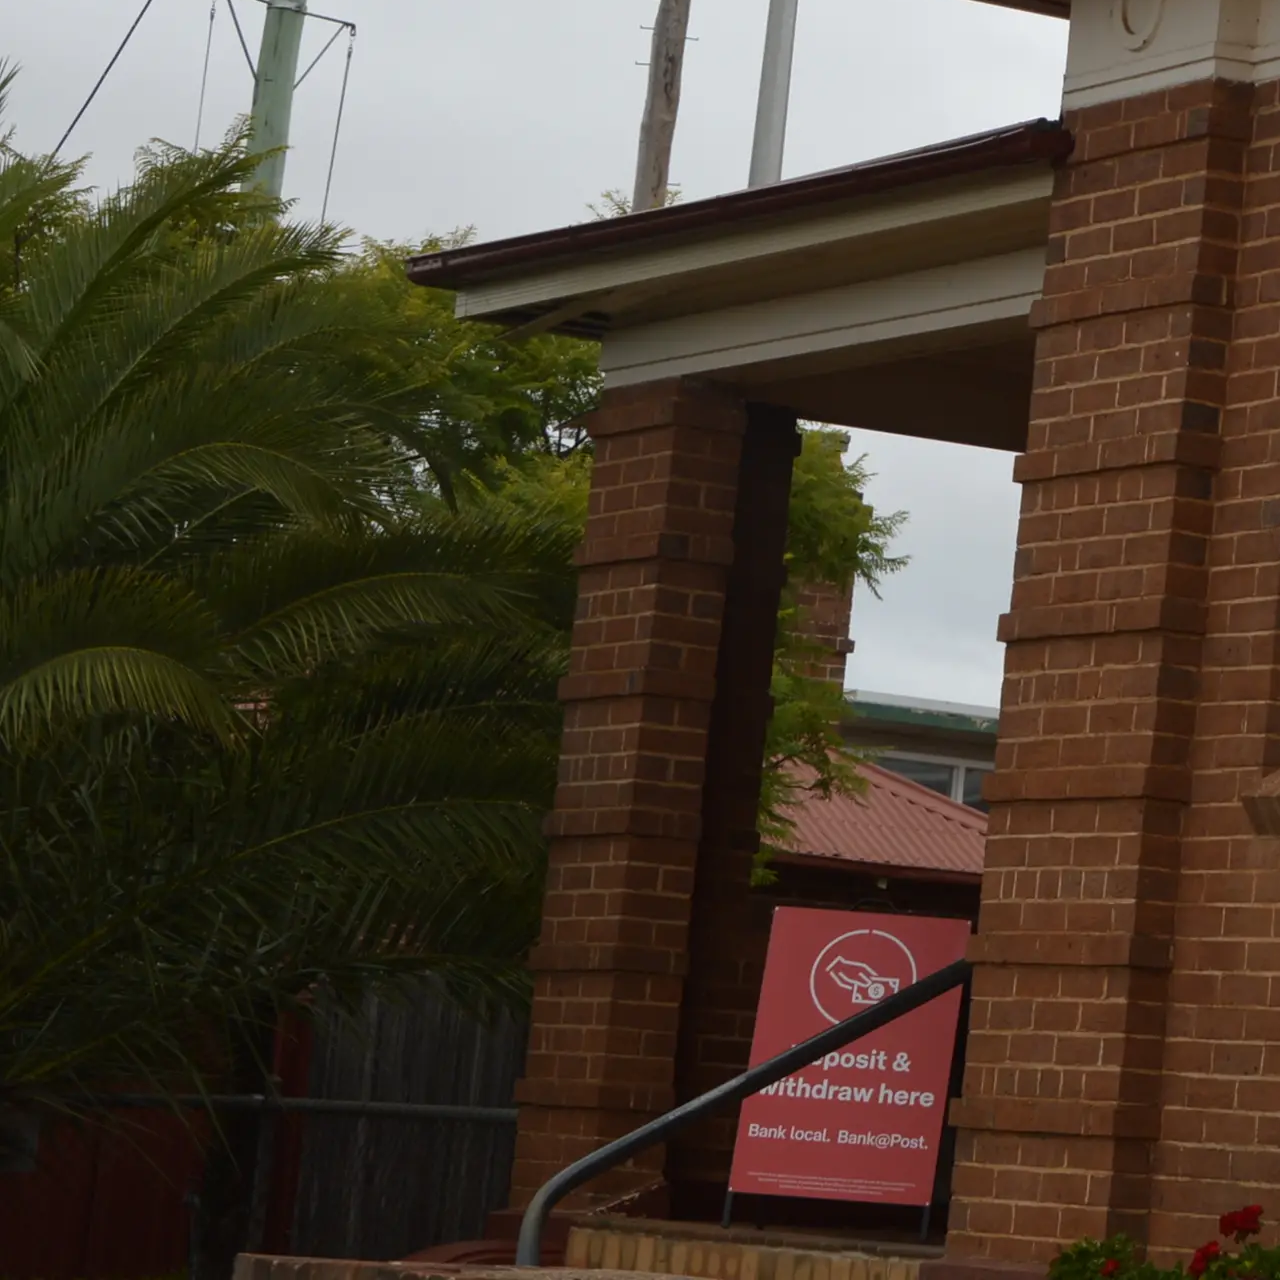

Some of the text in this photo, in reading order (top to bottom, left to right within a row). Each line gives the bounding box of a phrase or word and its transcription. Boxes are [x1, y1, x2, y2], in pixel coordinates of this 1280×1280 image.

[792, 1044, 911, 1073] posit &
[878, 1083, 935, 1108] here
[747, 1123, 929, 1150] Bank local. Bank@Post.
